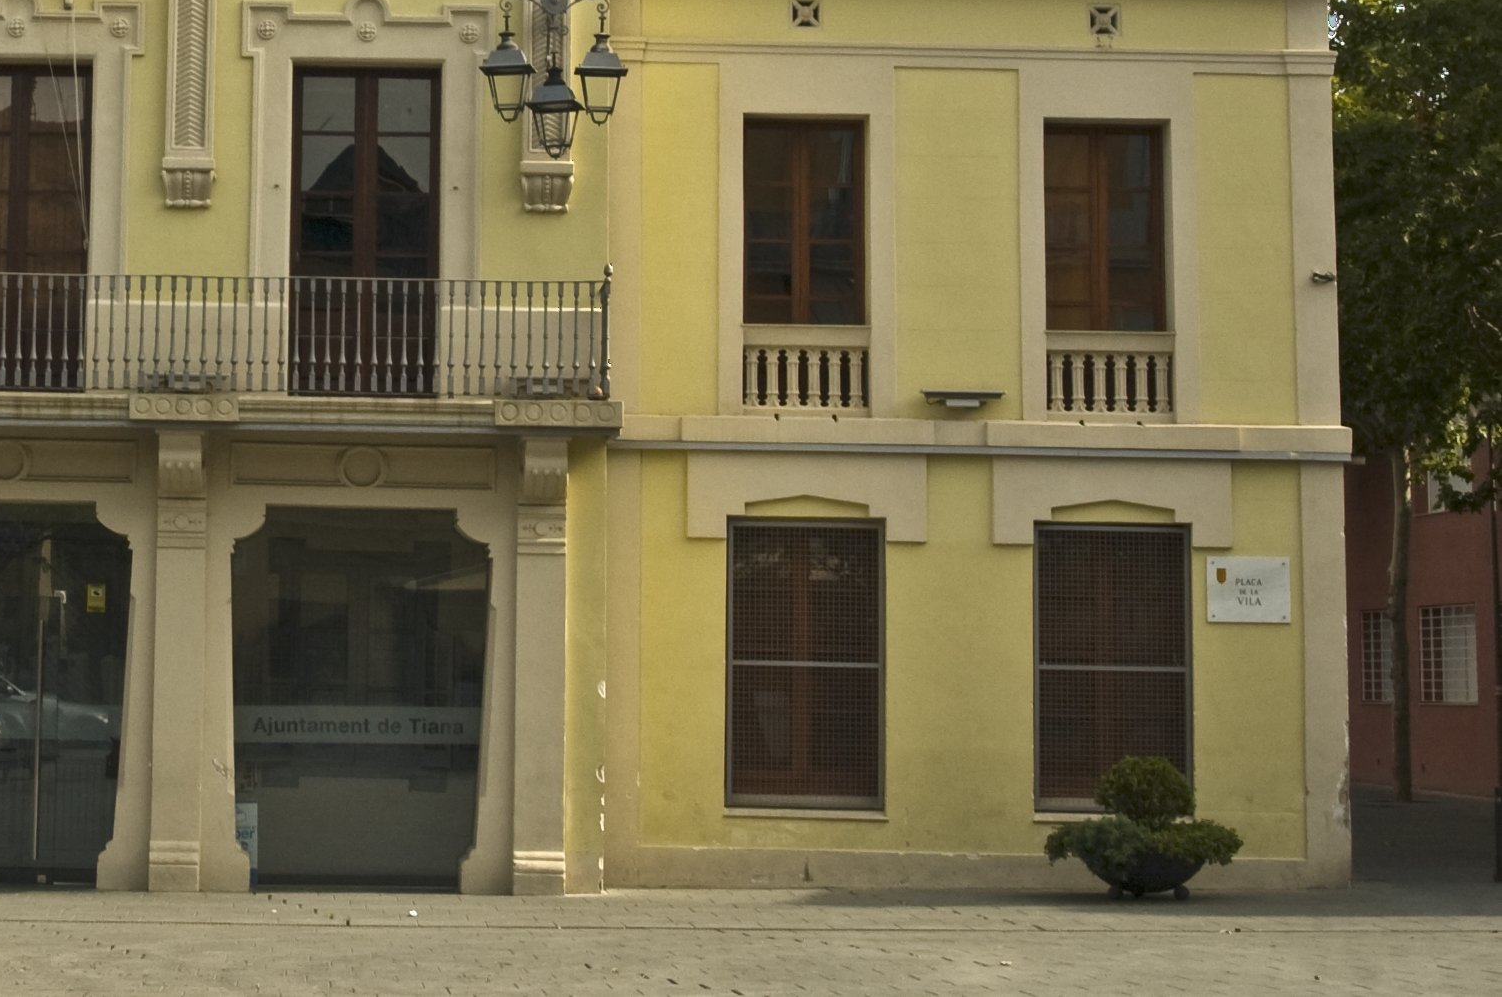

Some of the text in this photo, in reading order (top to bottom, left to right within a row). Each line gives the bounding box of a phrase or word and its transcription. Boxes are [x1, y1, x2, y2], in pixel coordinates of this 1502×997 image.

[1237, 596, 1262, 607] VILA
[253, 717, 464, 736] Ajuntament de Tiana
